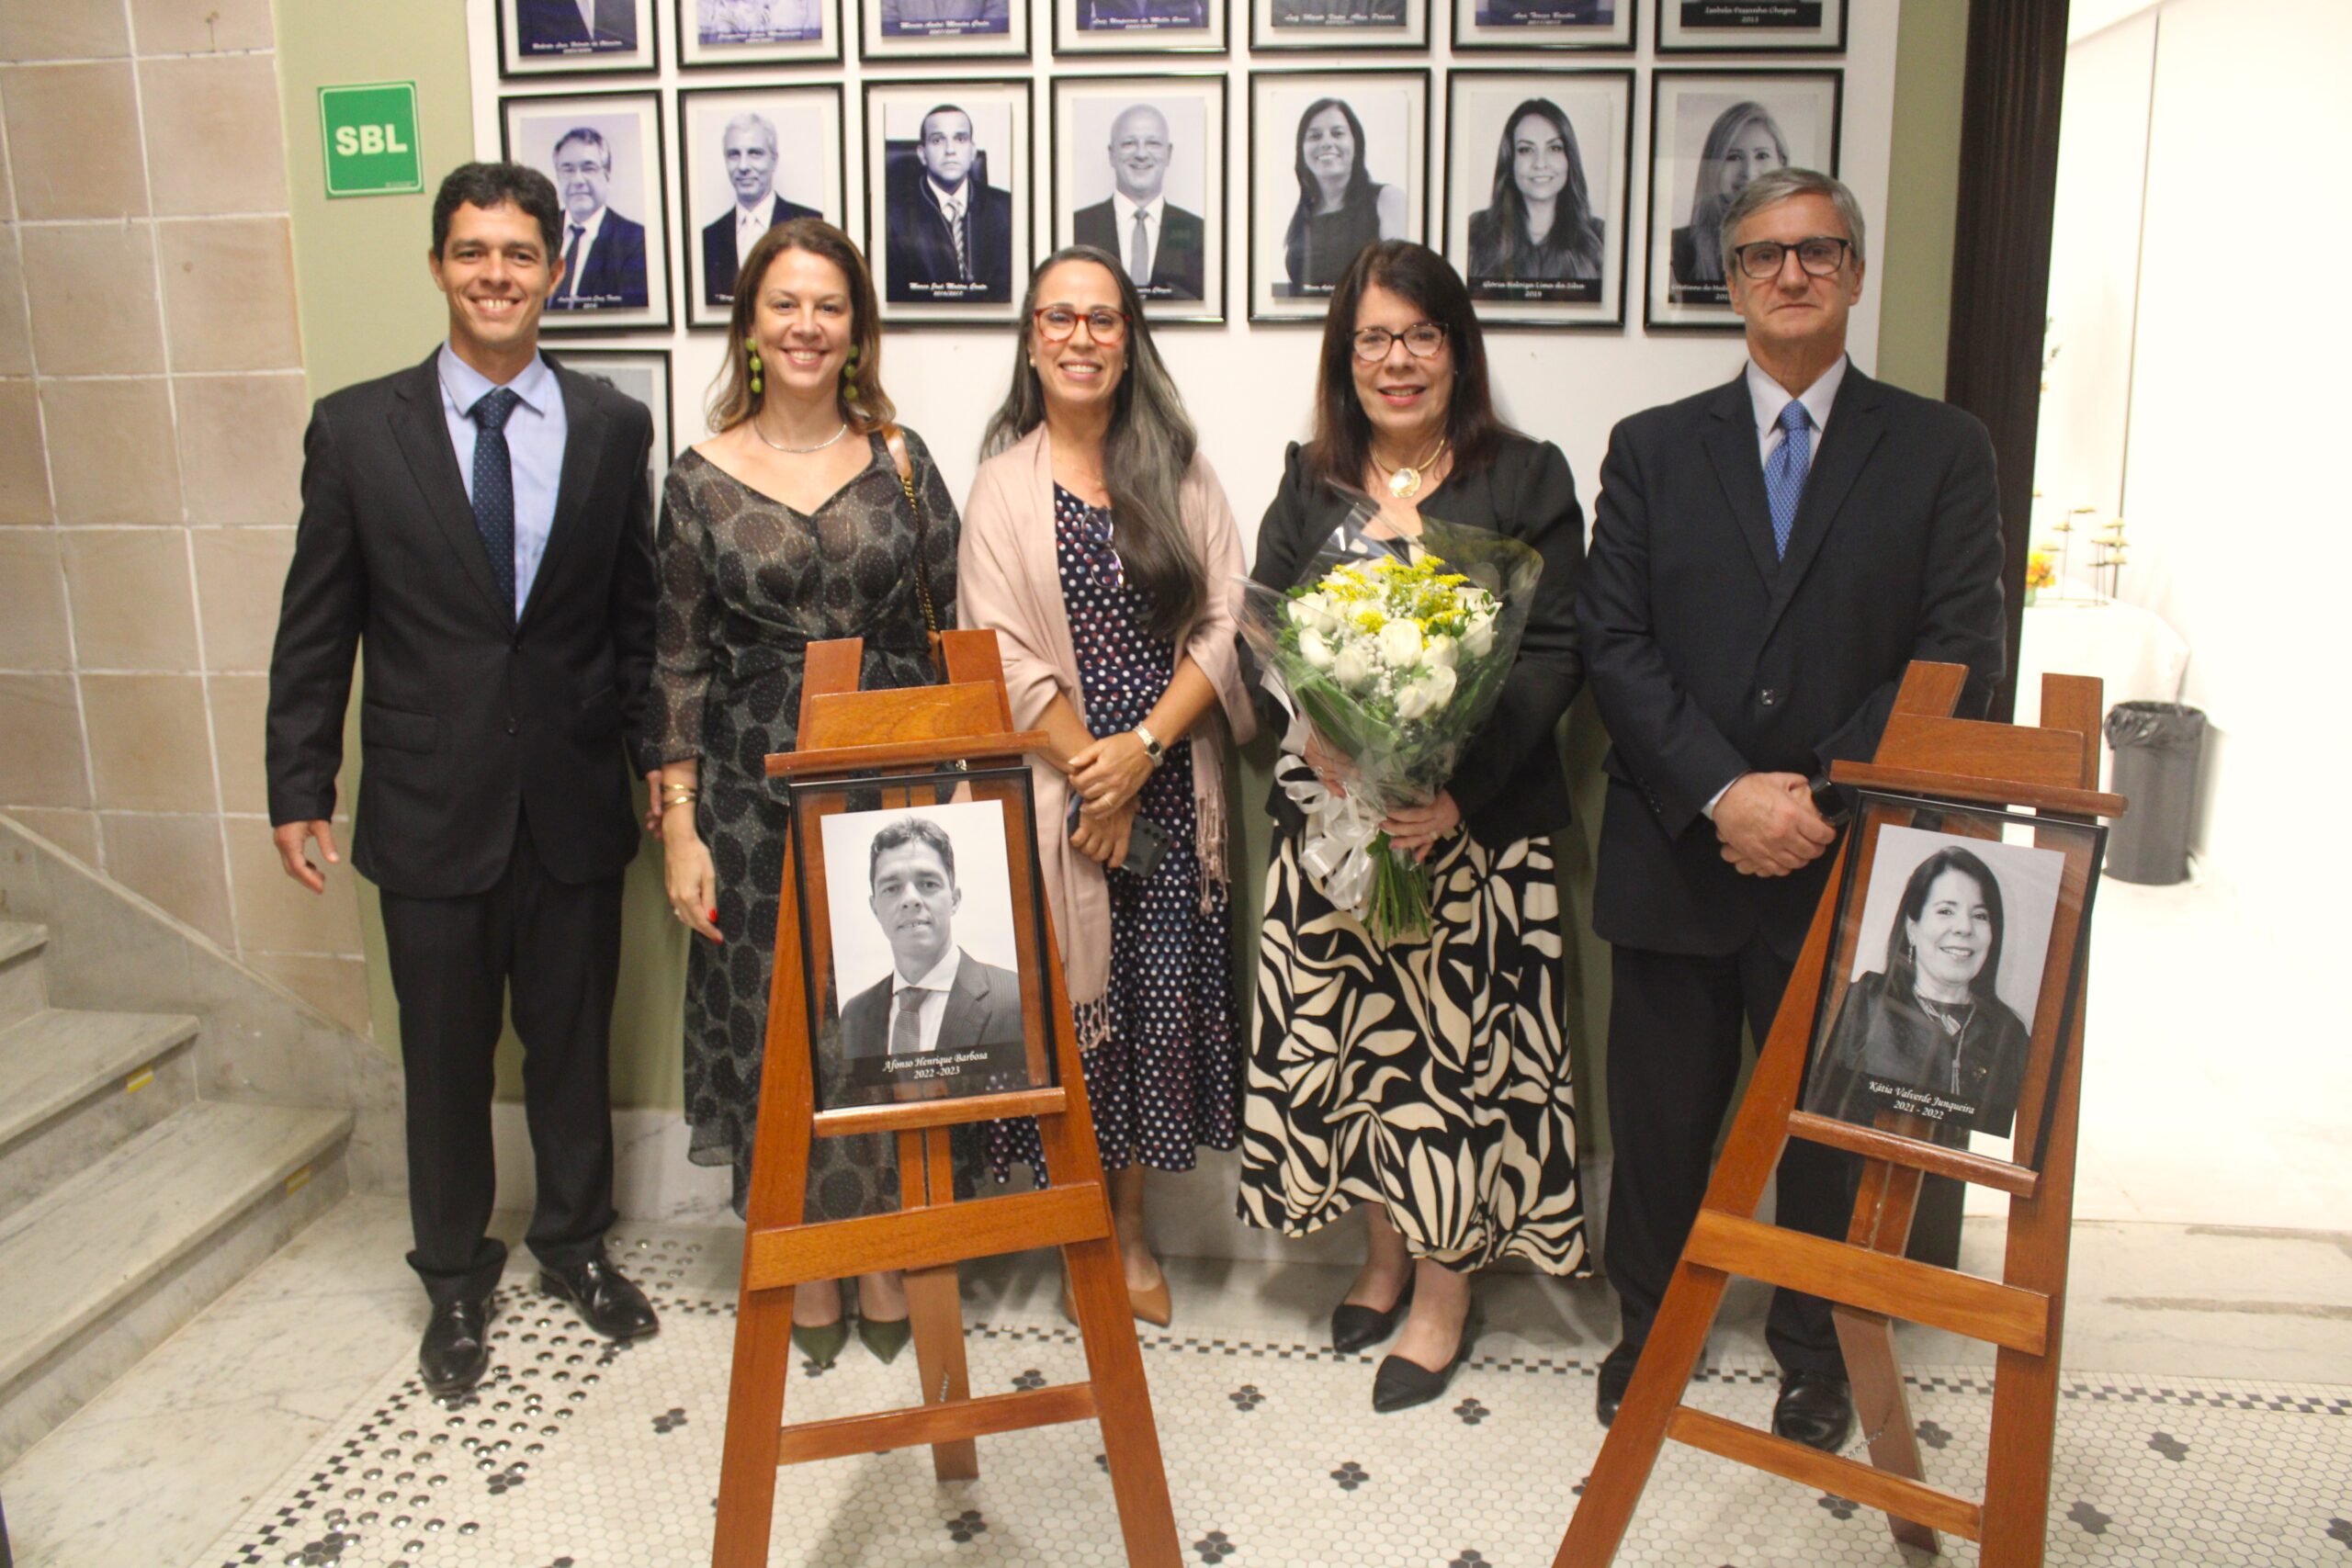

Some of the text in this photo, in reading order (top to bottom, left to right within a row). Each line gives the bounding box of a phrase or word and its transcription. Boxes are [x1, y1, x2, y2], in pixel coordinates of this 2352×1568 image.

[335, 123, 408, 156] SBL
[883, 1050, 989, 1073] Afonso Henrique Barbosa
[913, 1068, 934, 1079] 2022
[1869, 1080, 1975, 1115] Kátia Valverde Junqueira
[1894, 1100, 1915, 1113] 2021
[1921, 1106, 1945, 1120] 2022
